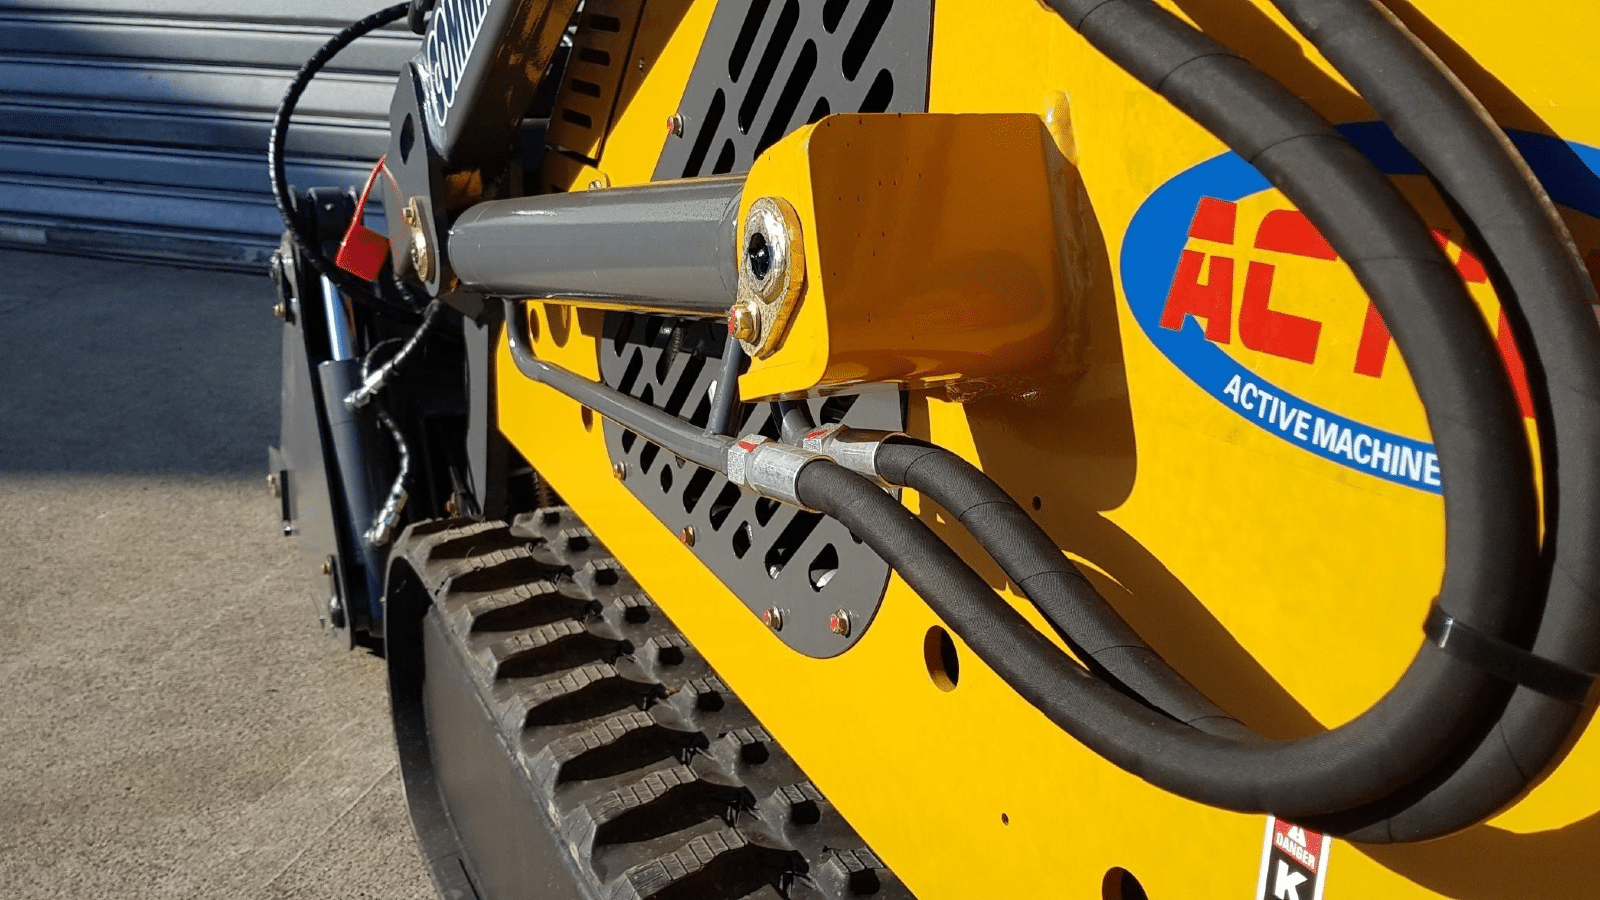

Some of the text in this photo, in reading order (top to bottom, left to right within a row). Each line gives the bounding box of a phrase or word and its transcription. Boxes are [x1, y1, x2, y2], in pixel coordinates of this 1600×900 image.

[1223, 374, 1442, 486] ACTIVE MACHINE
[1276, 832, 1316, 870] DANGER
